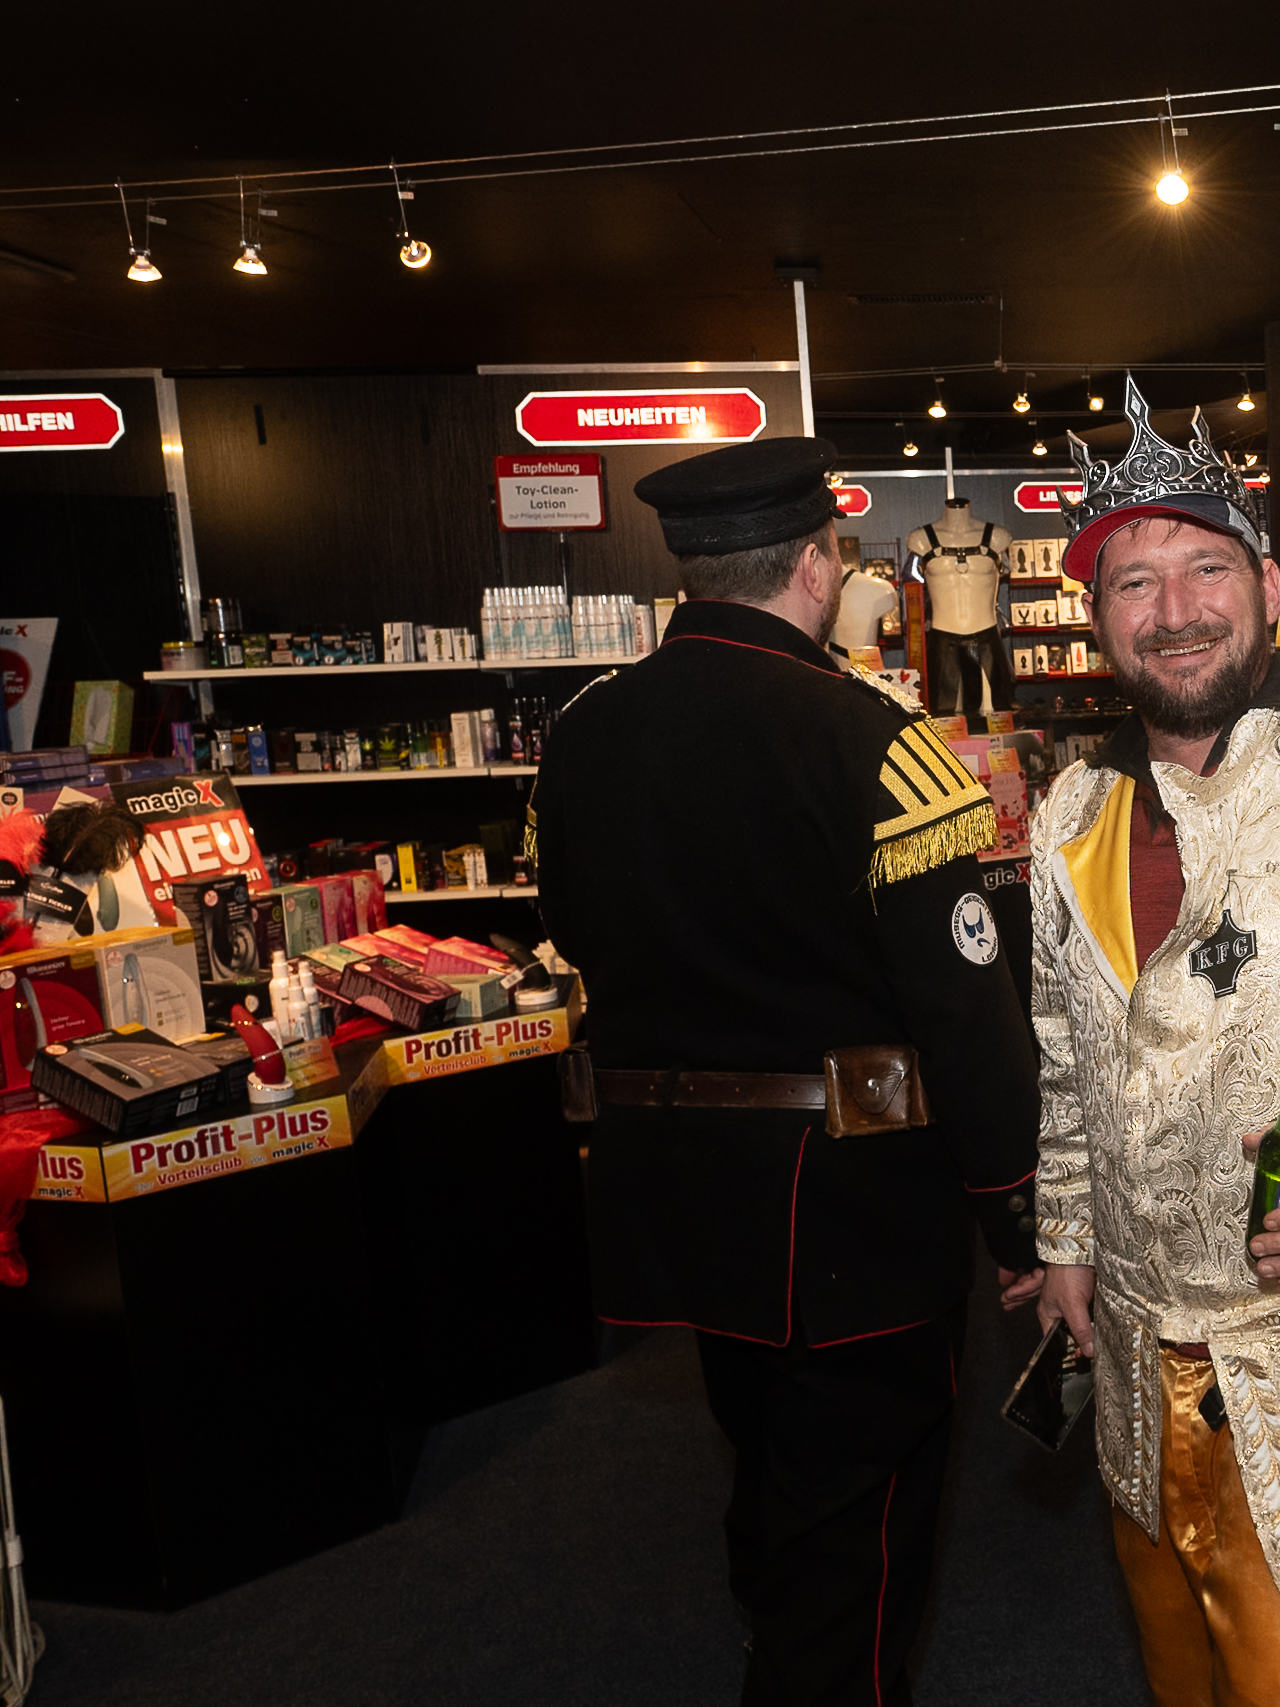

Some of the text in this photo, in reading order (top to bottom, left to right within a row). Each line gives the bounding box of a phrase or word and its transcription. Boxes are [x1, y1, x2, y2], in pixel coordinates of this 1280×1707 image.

[577, 406, 706, 426] NEUHEITEN
[513, 462, 580, 475] Empfehlung
[515, 485, 579, 496] Toy-Clean-
[530, 499, 567, 509] Lotion
[127, 779, 225, 814] magic X
[138, 818, 251, 882] NEU
[985, 868, 1016, 891] gic
[1196, 936, 1249, 971] KFG
[405, 1019, 552, 1064] Profit-Plus
[509, 1044, 540, 1059] magic
[541, 1040, 553, 1052] X
[131, 1108, 329, 1174] Profit-Plus
[157, 1157, 243, 1185] Vorteilsclub
[272, 1141, 314, 1158] magic
[316, 1135, 329, 1148] X
[38, 1186, 85, 1198] magic X
